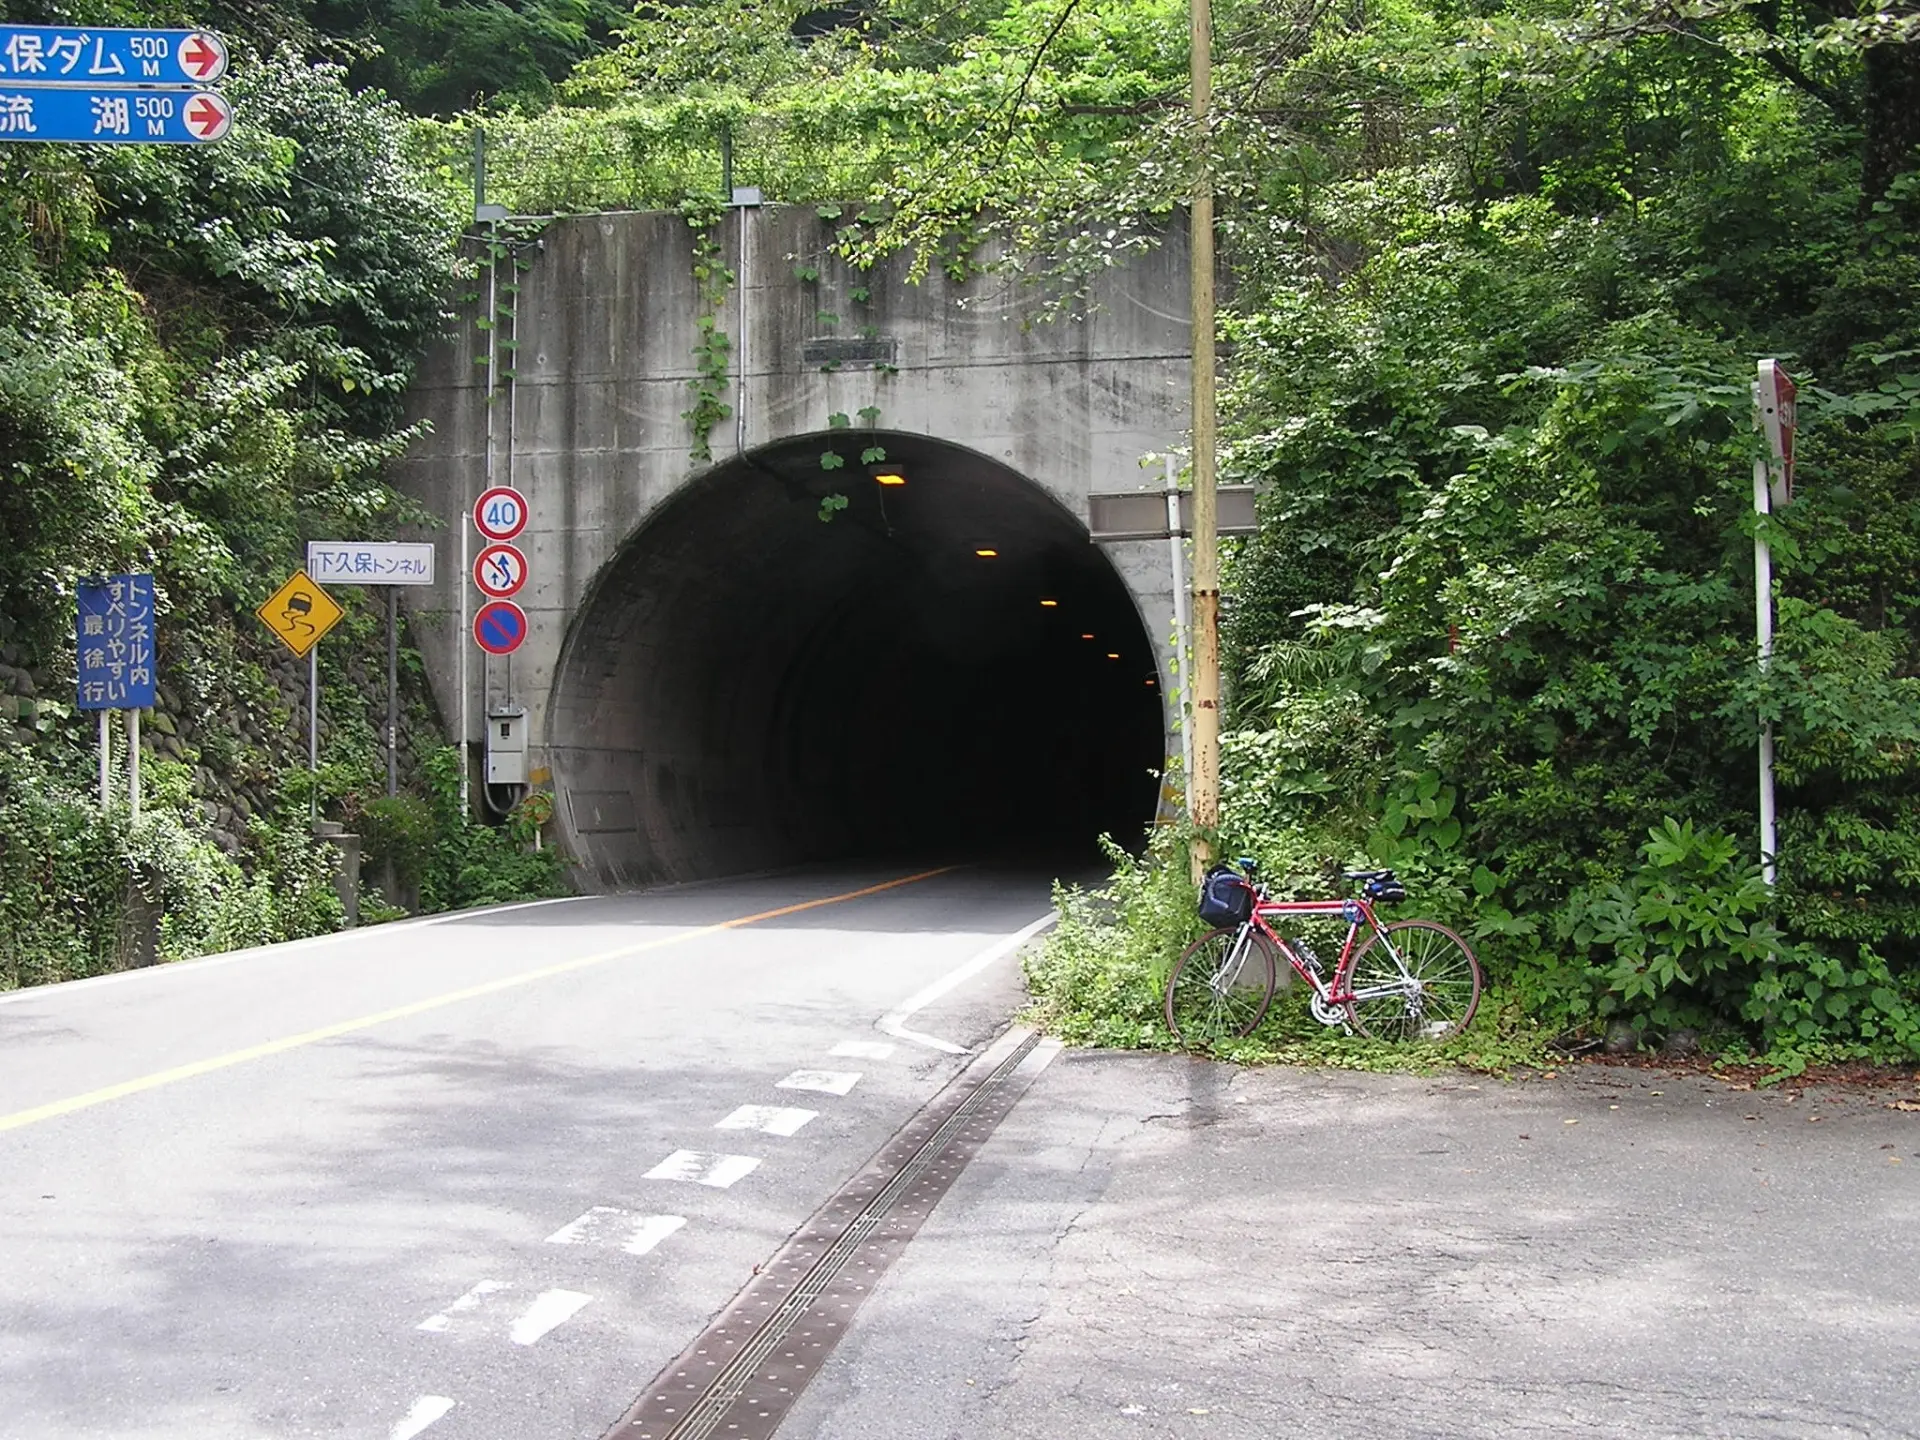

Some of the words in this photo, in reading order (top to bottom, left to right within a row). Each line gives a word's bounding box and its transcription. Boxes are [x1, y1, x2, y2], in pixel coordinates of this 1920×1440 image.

[0, 34, 125, 75] 保ダム
[130, 37, 168, 58] 500
[142, 60, 160, 76] M
[135, 97, 174, 118] 500
[147, 120, 165, 136] M
[487, 502, 516, 526] 40
[316, 551, 426, 575] 下久保トンネル
[106, 580, 127, 701] すべりやすい
[129, 580, 150, 686] トンネル内
[83, 614, 105, 702] 最徐行
